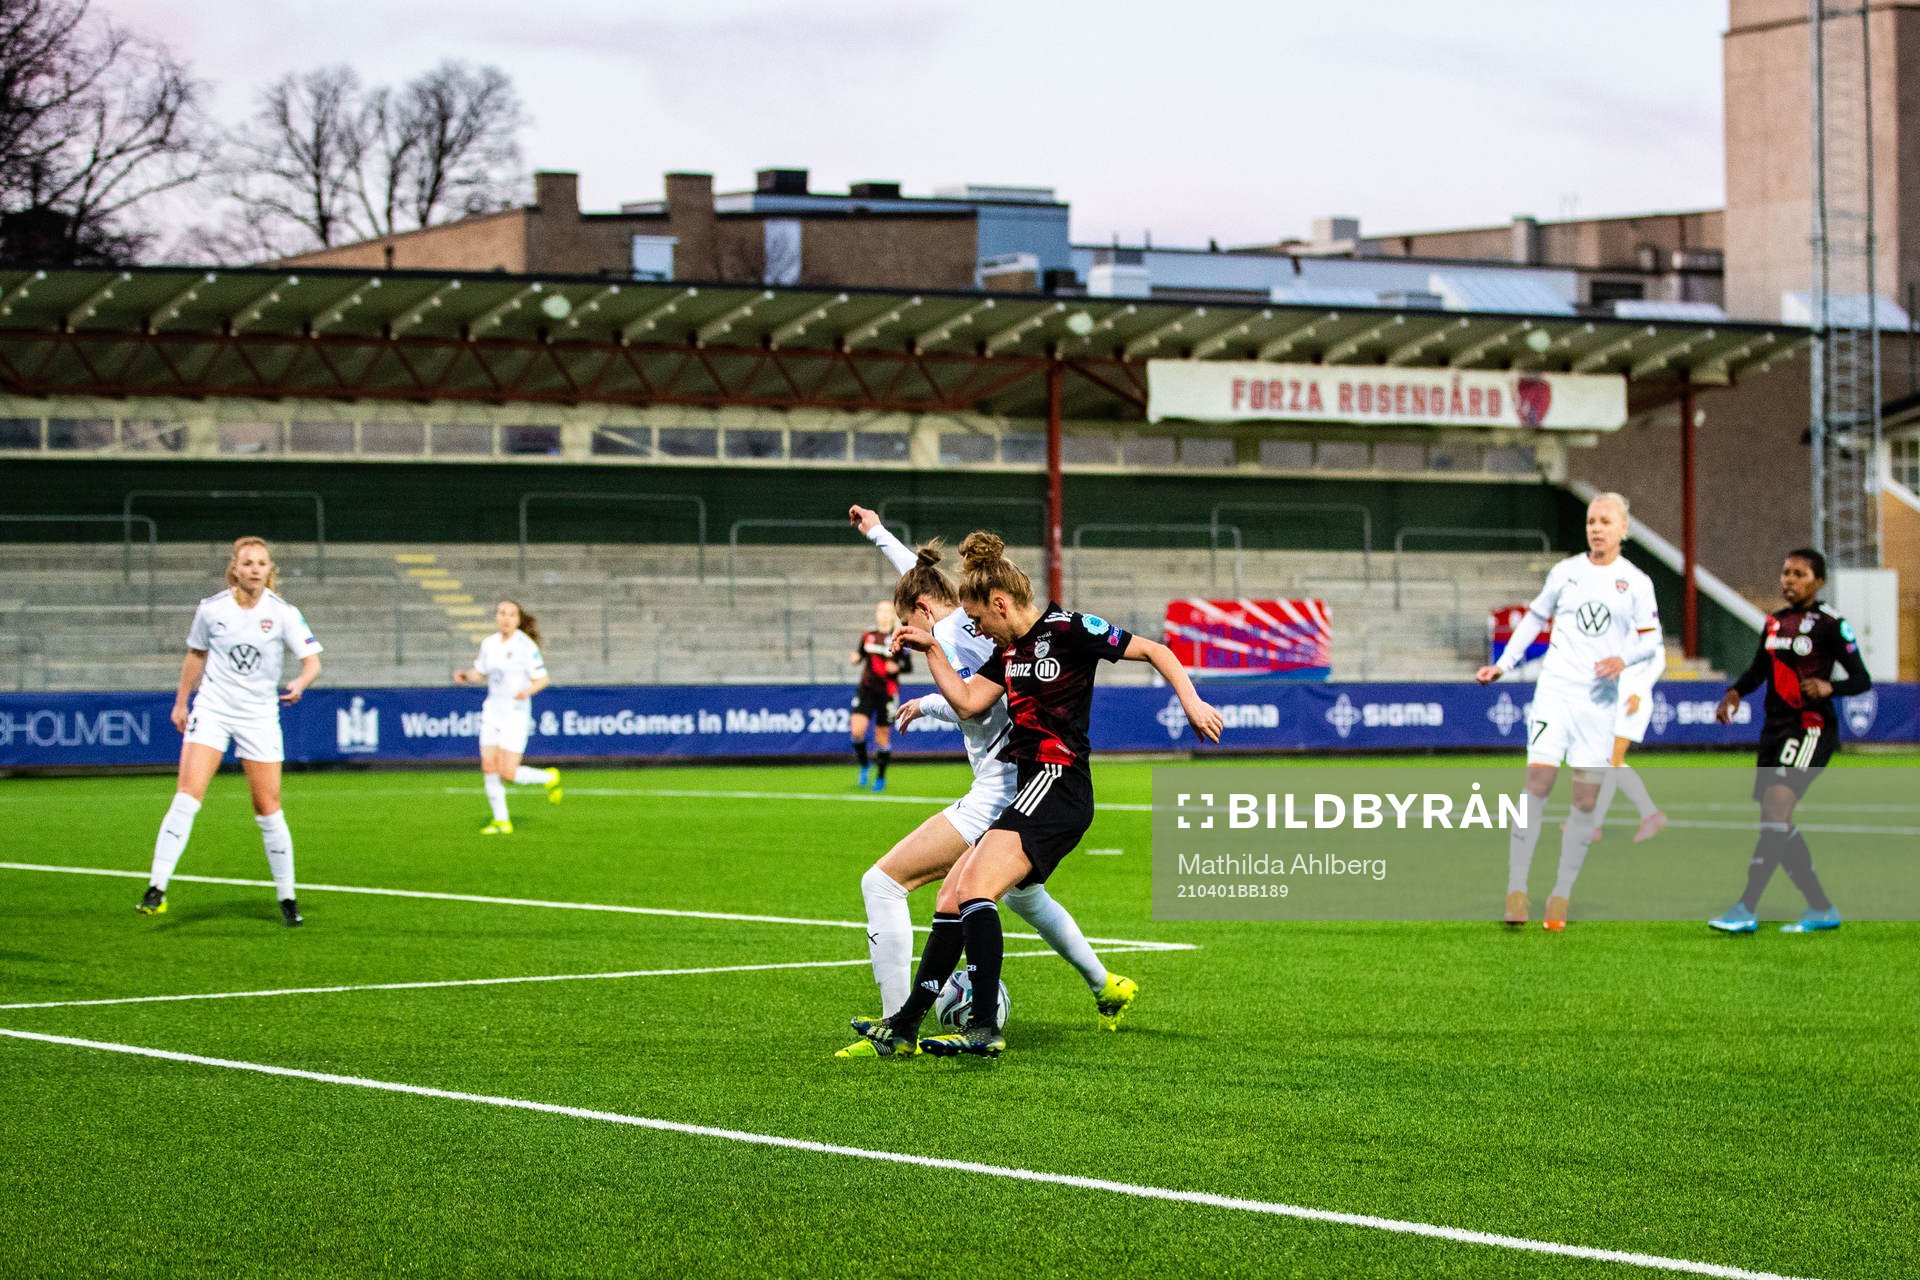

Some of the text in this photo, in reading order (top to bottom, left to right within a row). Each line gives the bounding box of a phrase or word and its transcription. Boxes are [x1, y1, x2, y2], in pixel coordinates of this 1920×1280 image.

[1231, 372, 1502, 418] FORZA ROSENGÅRD
[1004, 658, 1032, 679] lianz
[539, 710, 560, 736] &
[562, 709, 694, 736] EuroGames
[698, 709, 722, 734] in
[725, 707, 806, 733] Malmö
[807, 707, 851, 733] 202
[1779, 737, 1800, 766] 6
